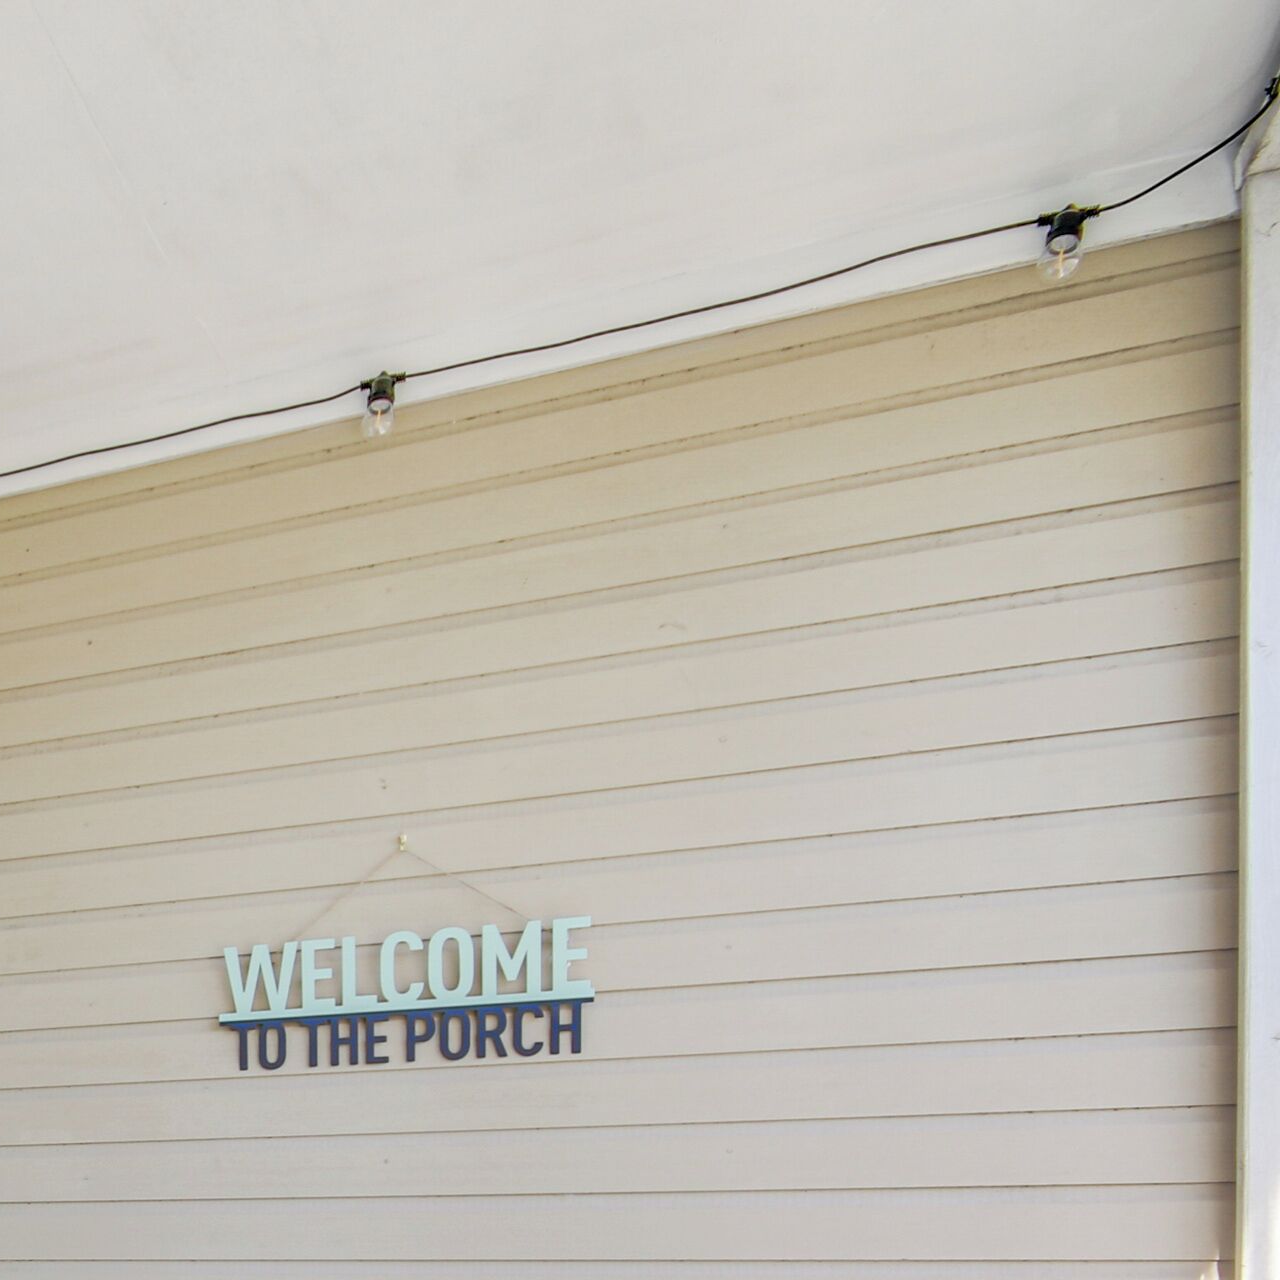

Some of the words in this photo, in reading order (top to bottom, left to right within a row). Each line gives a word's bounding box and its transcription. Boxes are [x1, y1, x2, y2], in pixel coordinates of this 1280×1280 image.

[224, 914, 592, 1014] WELCOME
[229, 1020, 287, 1071] TO
[299, 1014, 389, 1067] THE
[405, 1000, 582, 1062] PORCH
